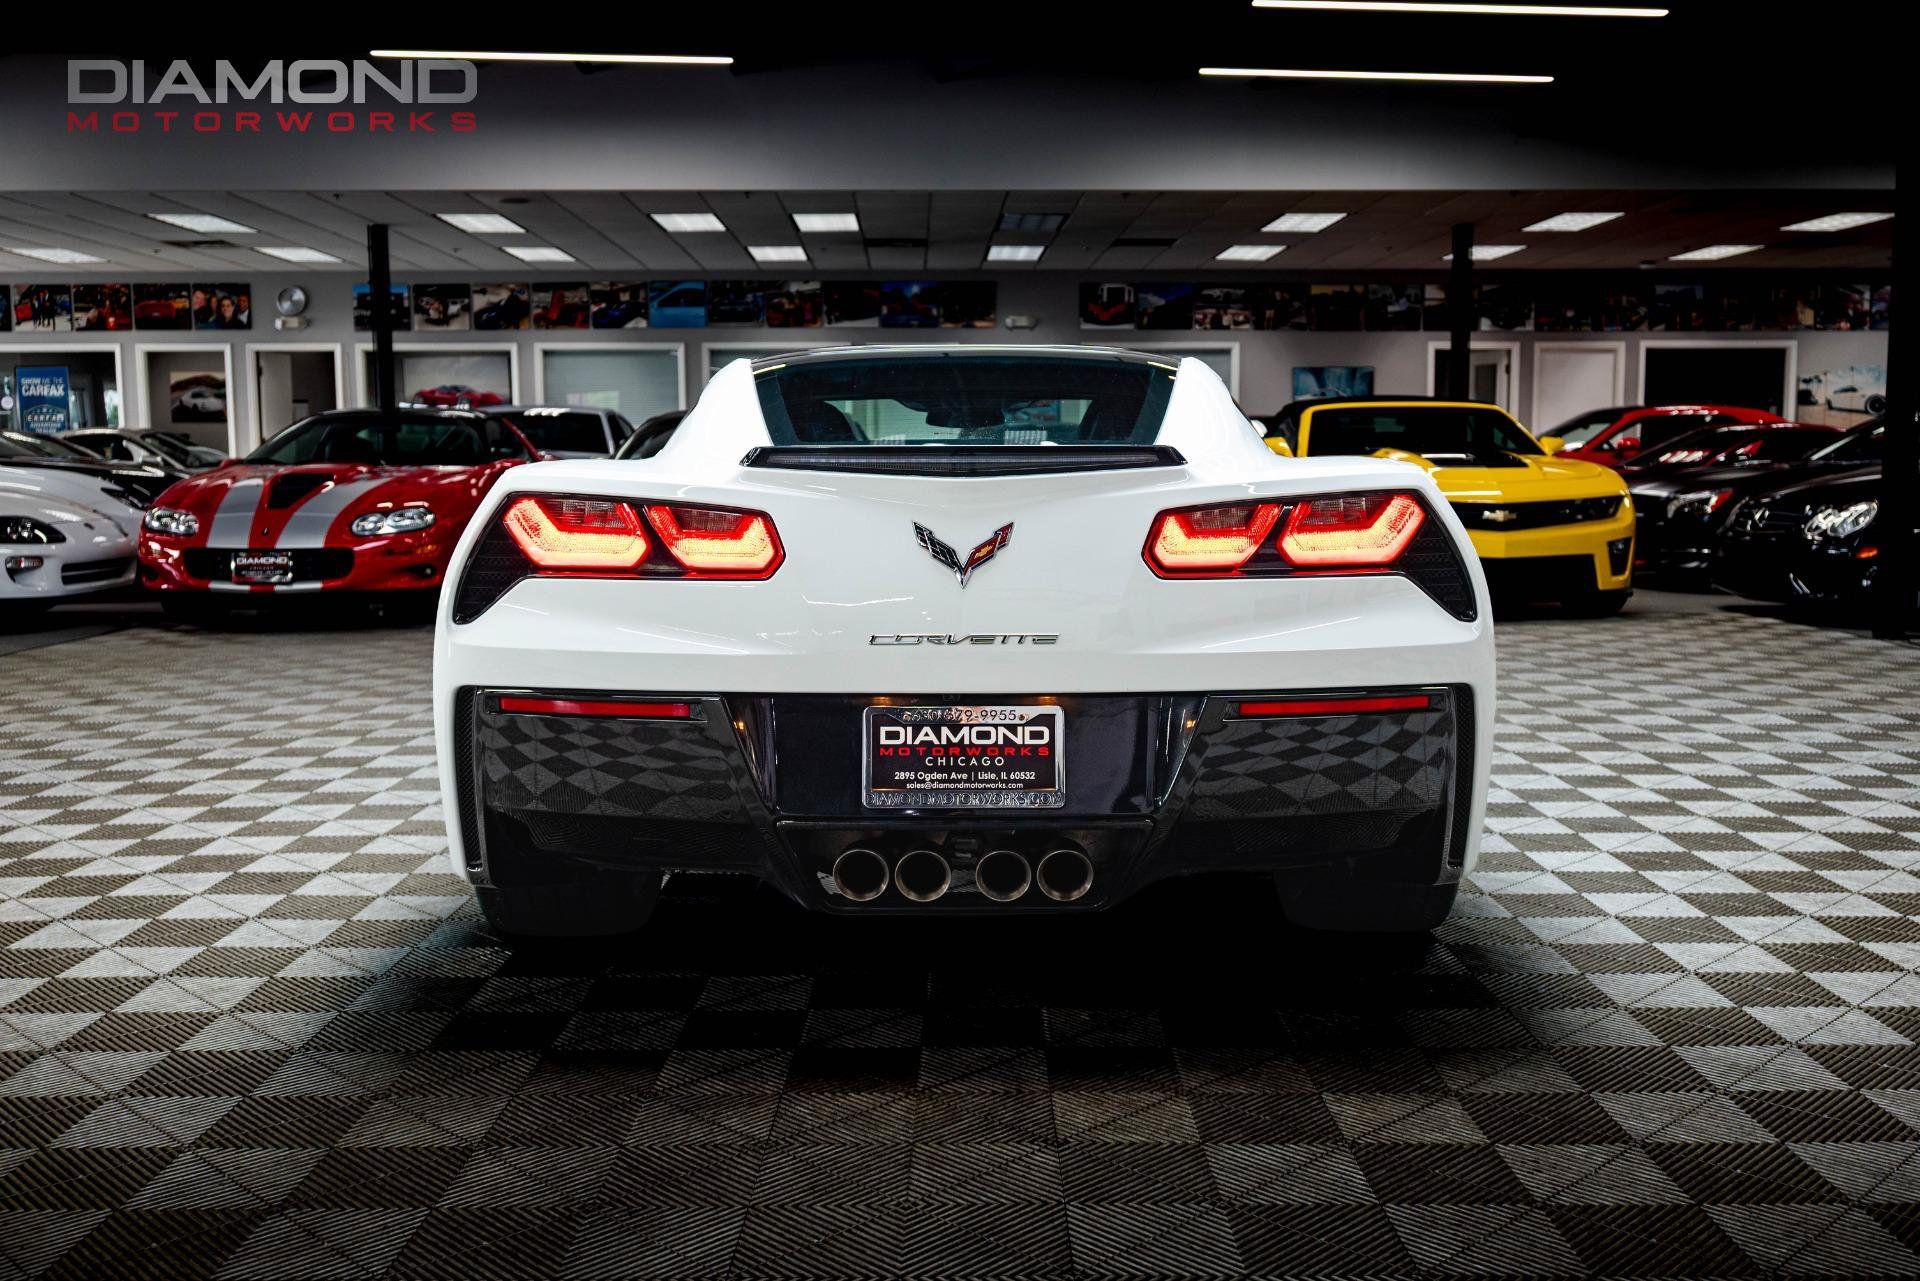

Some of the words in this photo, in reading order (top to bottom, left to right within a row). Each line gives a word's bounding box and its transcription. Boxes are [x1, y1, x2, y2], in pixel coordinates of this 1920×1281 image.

[22, 384, 65, 396] CARFAX
[236, 557, 288, 565] DIAMOND
[869, 633, 1060, 646] CORVETTE
[879, 726, 1050, 745] DIAMOND
[879, 746, 1050, 757] MOTORWORKS
[925, 757, 1005, 766] CHICAGO
[894, 772, 916, 780] 2895
[917, 771, 948, 782] Ogden
[950, 772, 968, 780] Ave
[978, 772, 999, 781] Lisle,
[1001, 772, 1008, 780] IL
[1009, 772, 1036, 780] 60532
[906, 781, 1024, 790] sales@diamondmotorworks.com
[865, 793, 1063, 806] DIAMONDMOTORWORKS.COM
